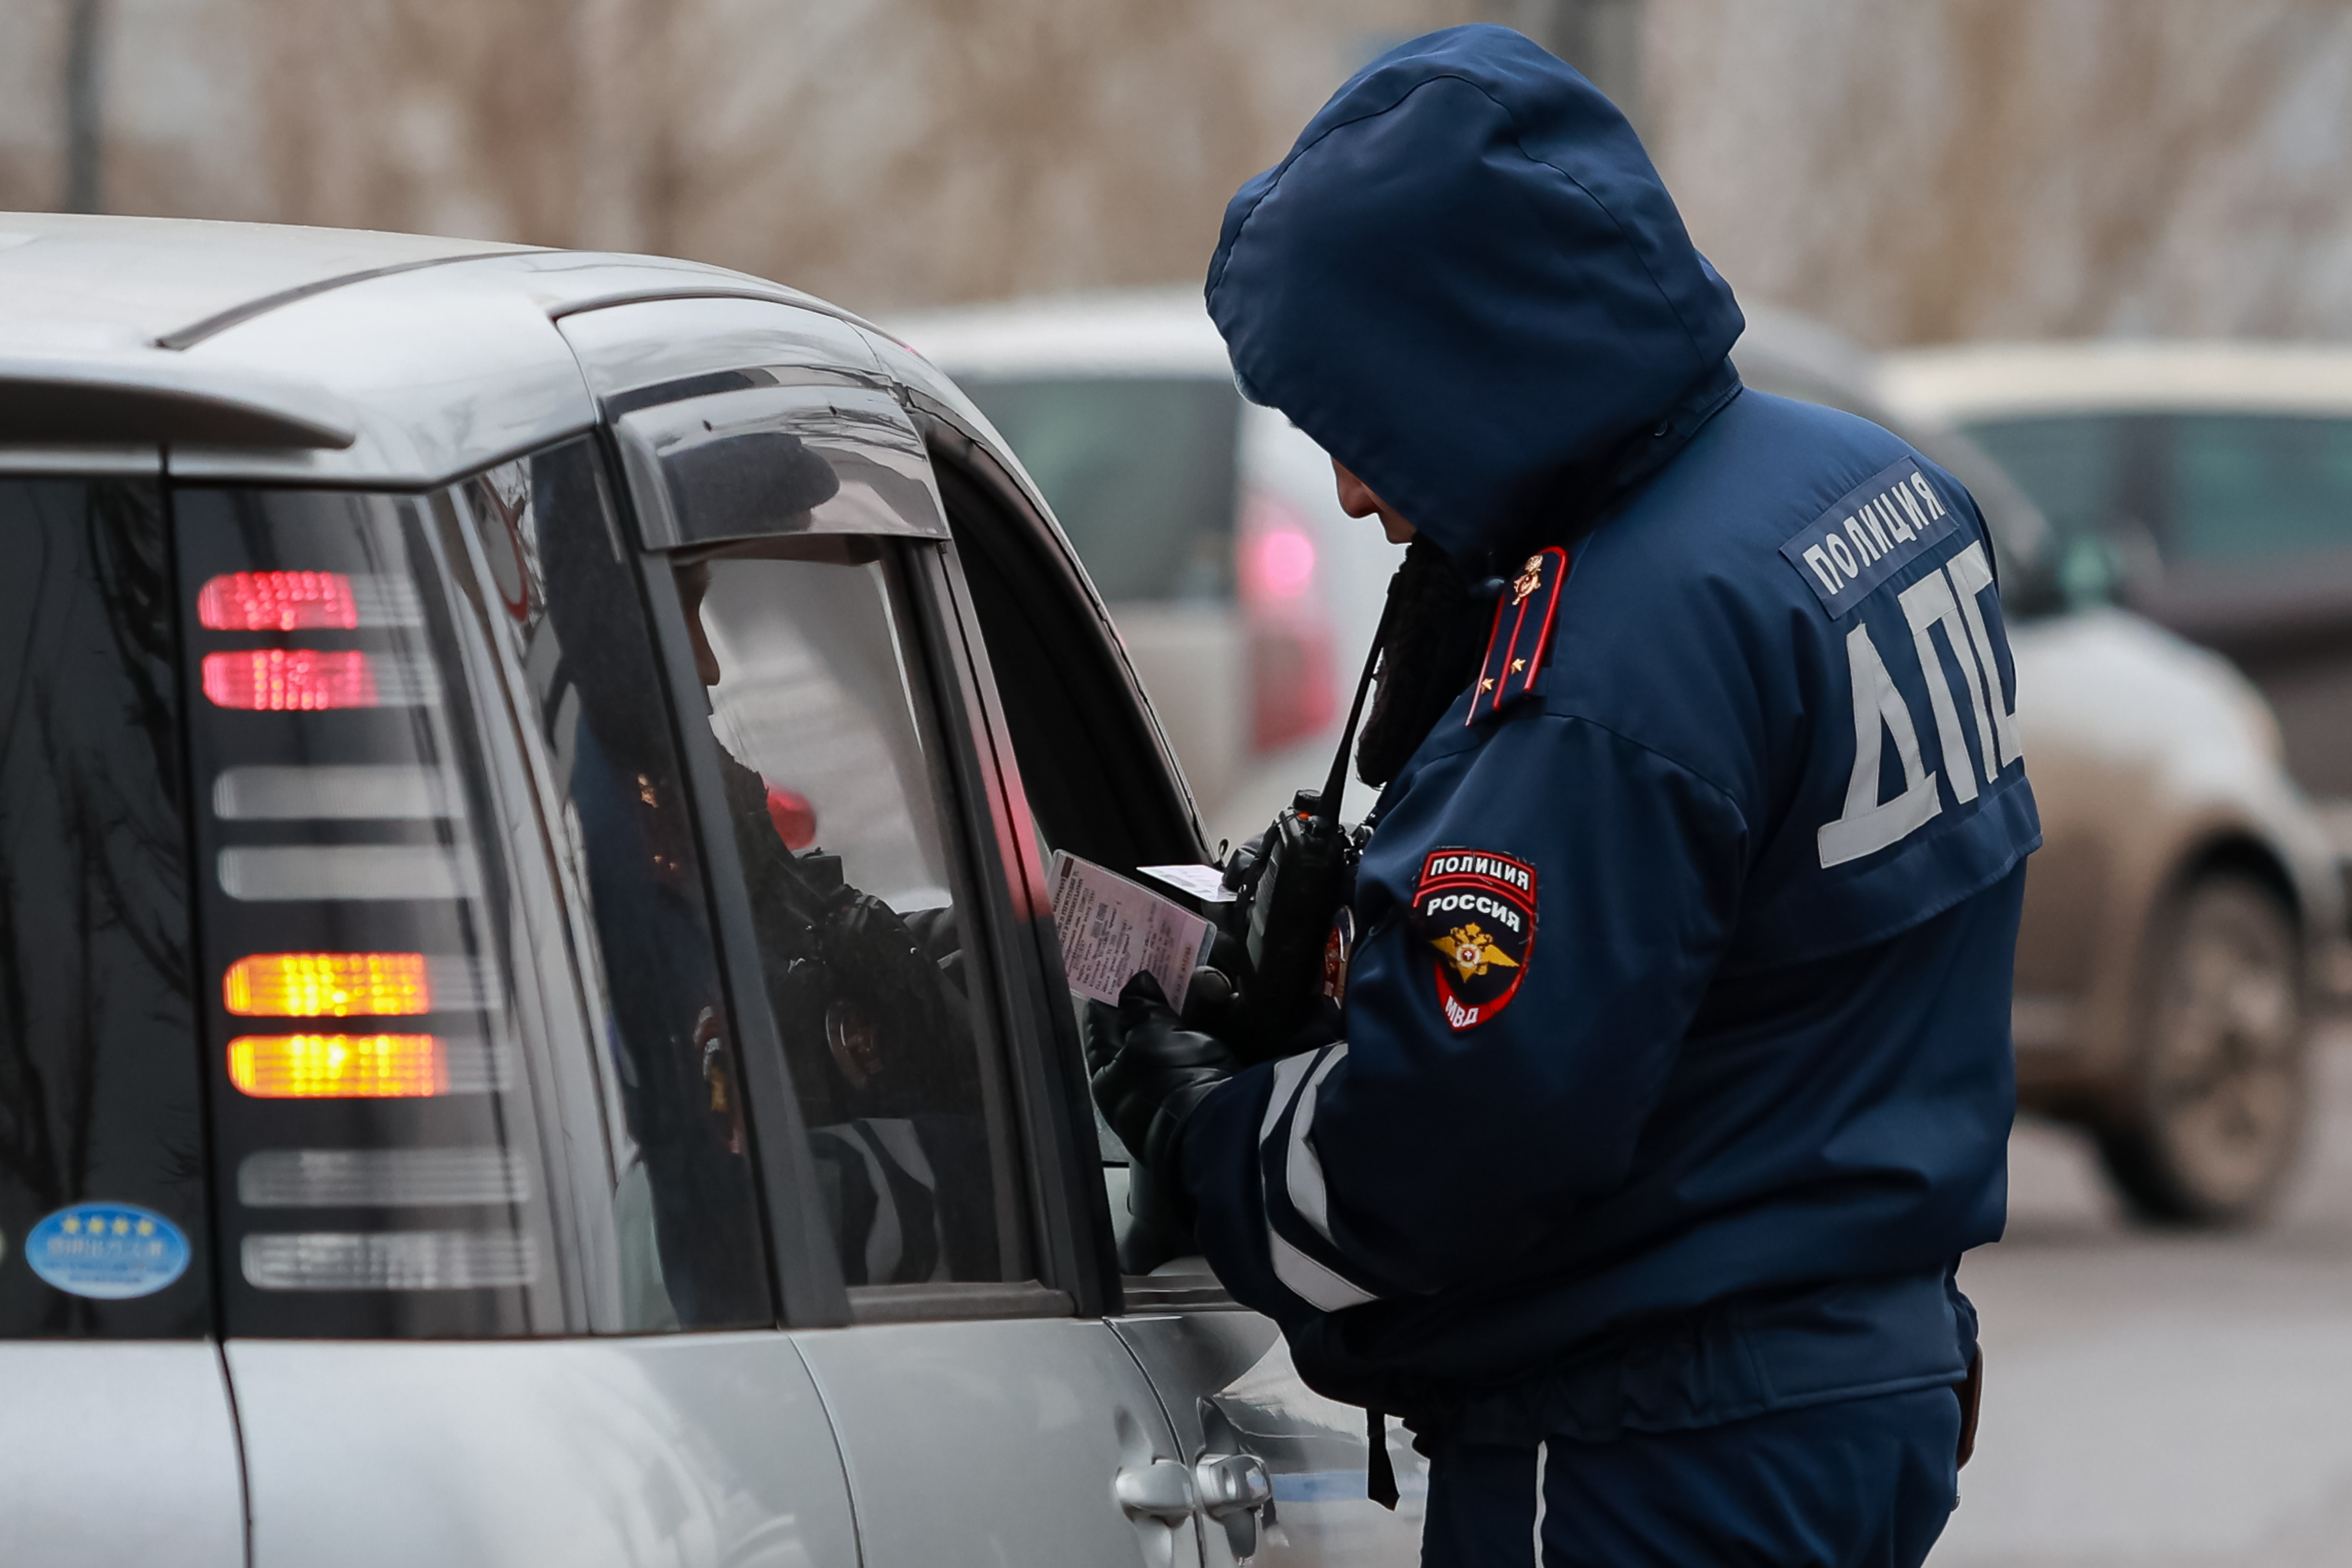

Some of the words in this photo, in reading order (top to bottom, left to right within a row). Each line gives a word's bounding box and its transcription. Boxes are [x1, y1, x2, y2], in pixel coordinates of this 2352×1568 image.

[1802, 472, 1946, 596] ПОЛИЦИЯ
[1430, 856, 1529, 891] ПОЛИЦИЯ
[1426, 894, 1521, 933] РОССИЯ
[1445, 995, 1479, 1028] МВД
